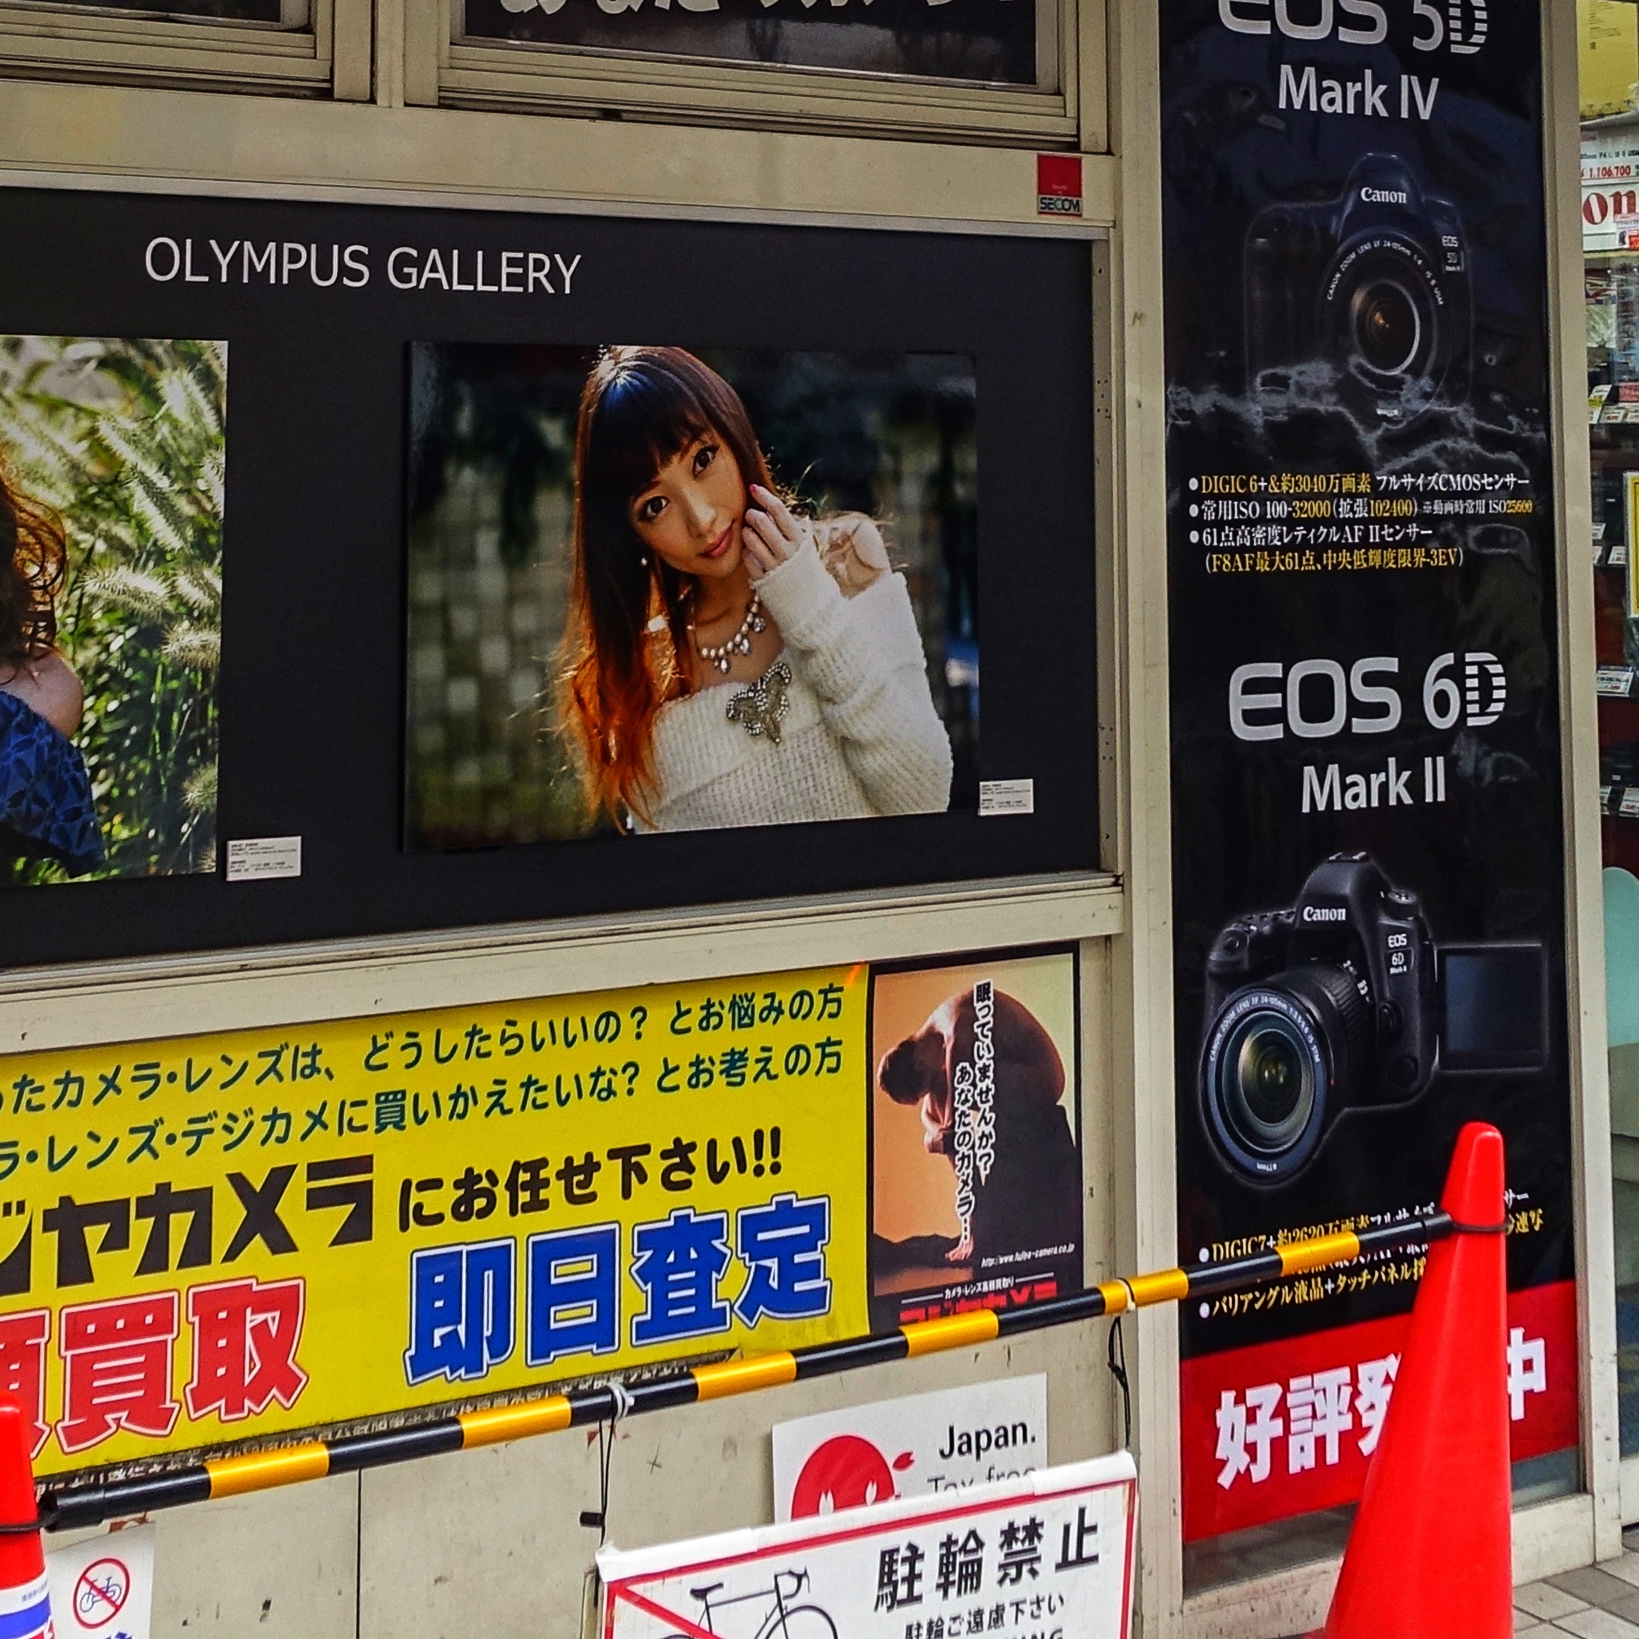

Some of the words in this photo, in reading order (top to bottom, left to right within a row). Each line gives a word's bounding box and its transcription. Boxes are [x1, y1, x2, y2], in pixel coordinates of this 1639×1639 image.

[1278, 64, 1389, 118] Mark
[1400, 74, 1439, 120] IV
[1040, 197, 1080, 212] SECOM
[1360, 187, 1407, 204] Canon
[144, 236, 372, 290] OLYMPUS
[386, 244, 582, 297] GALLERY
[1201, 475, 1248, 494] DIGIC
[1376, 472, 1530, 492] フルサイズCMOSセンサー
[1201, 500, 1258, 521] 常用ISO
[1228, 656, 1402, 742] EOS
[1422, 651, 1507, 731] 6D
[1301, 758, 1414, 813] Mark
[1424, 756, 1446, 803] II
[1303, 906, 1346, 922] Canon
[1388, 933, 1407, 948] EOS
[973, 980, 996, 1176] 眠っていませんか?
[399, 1126, 782, 1233] にお任せ下さい!!
[405, 1191, 833, 1384] 即日査定
[1216, 1327, 1547, 1490] 好評発中
[939, 1421, 1037, 1462] Japan.
[874, 1505, 1100, 1614] 駐輪禁止
[905, 1593, 1065, 1639] 駐輪ご遠慮下さい
